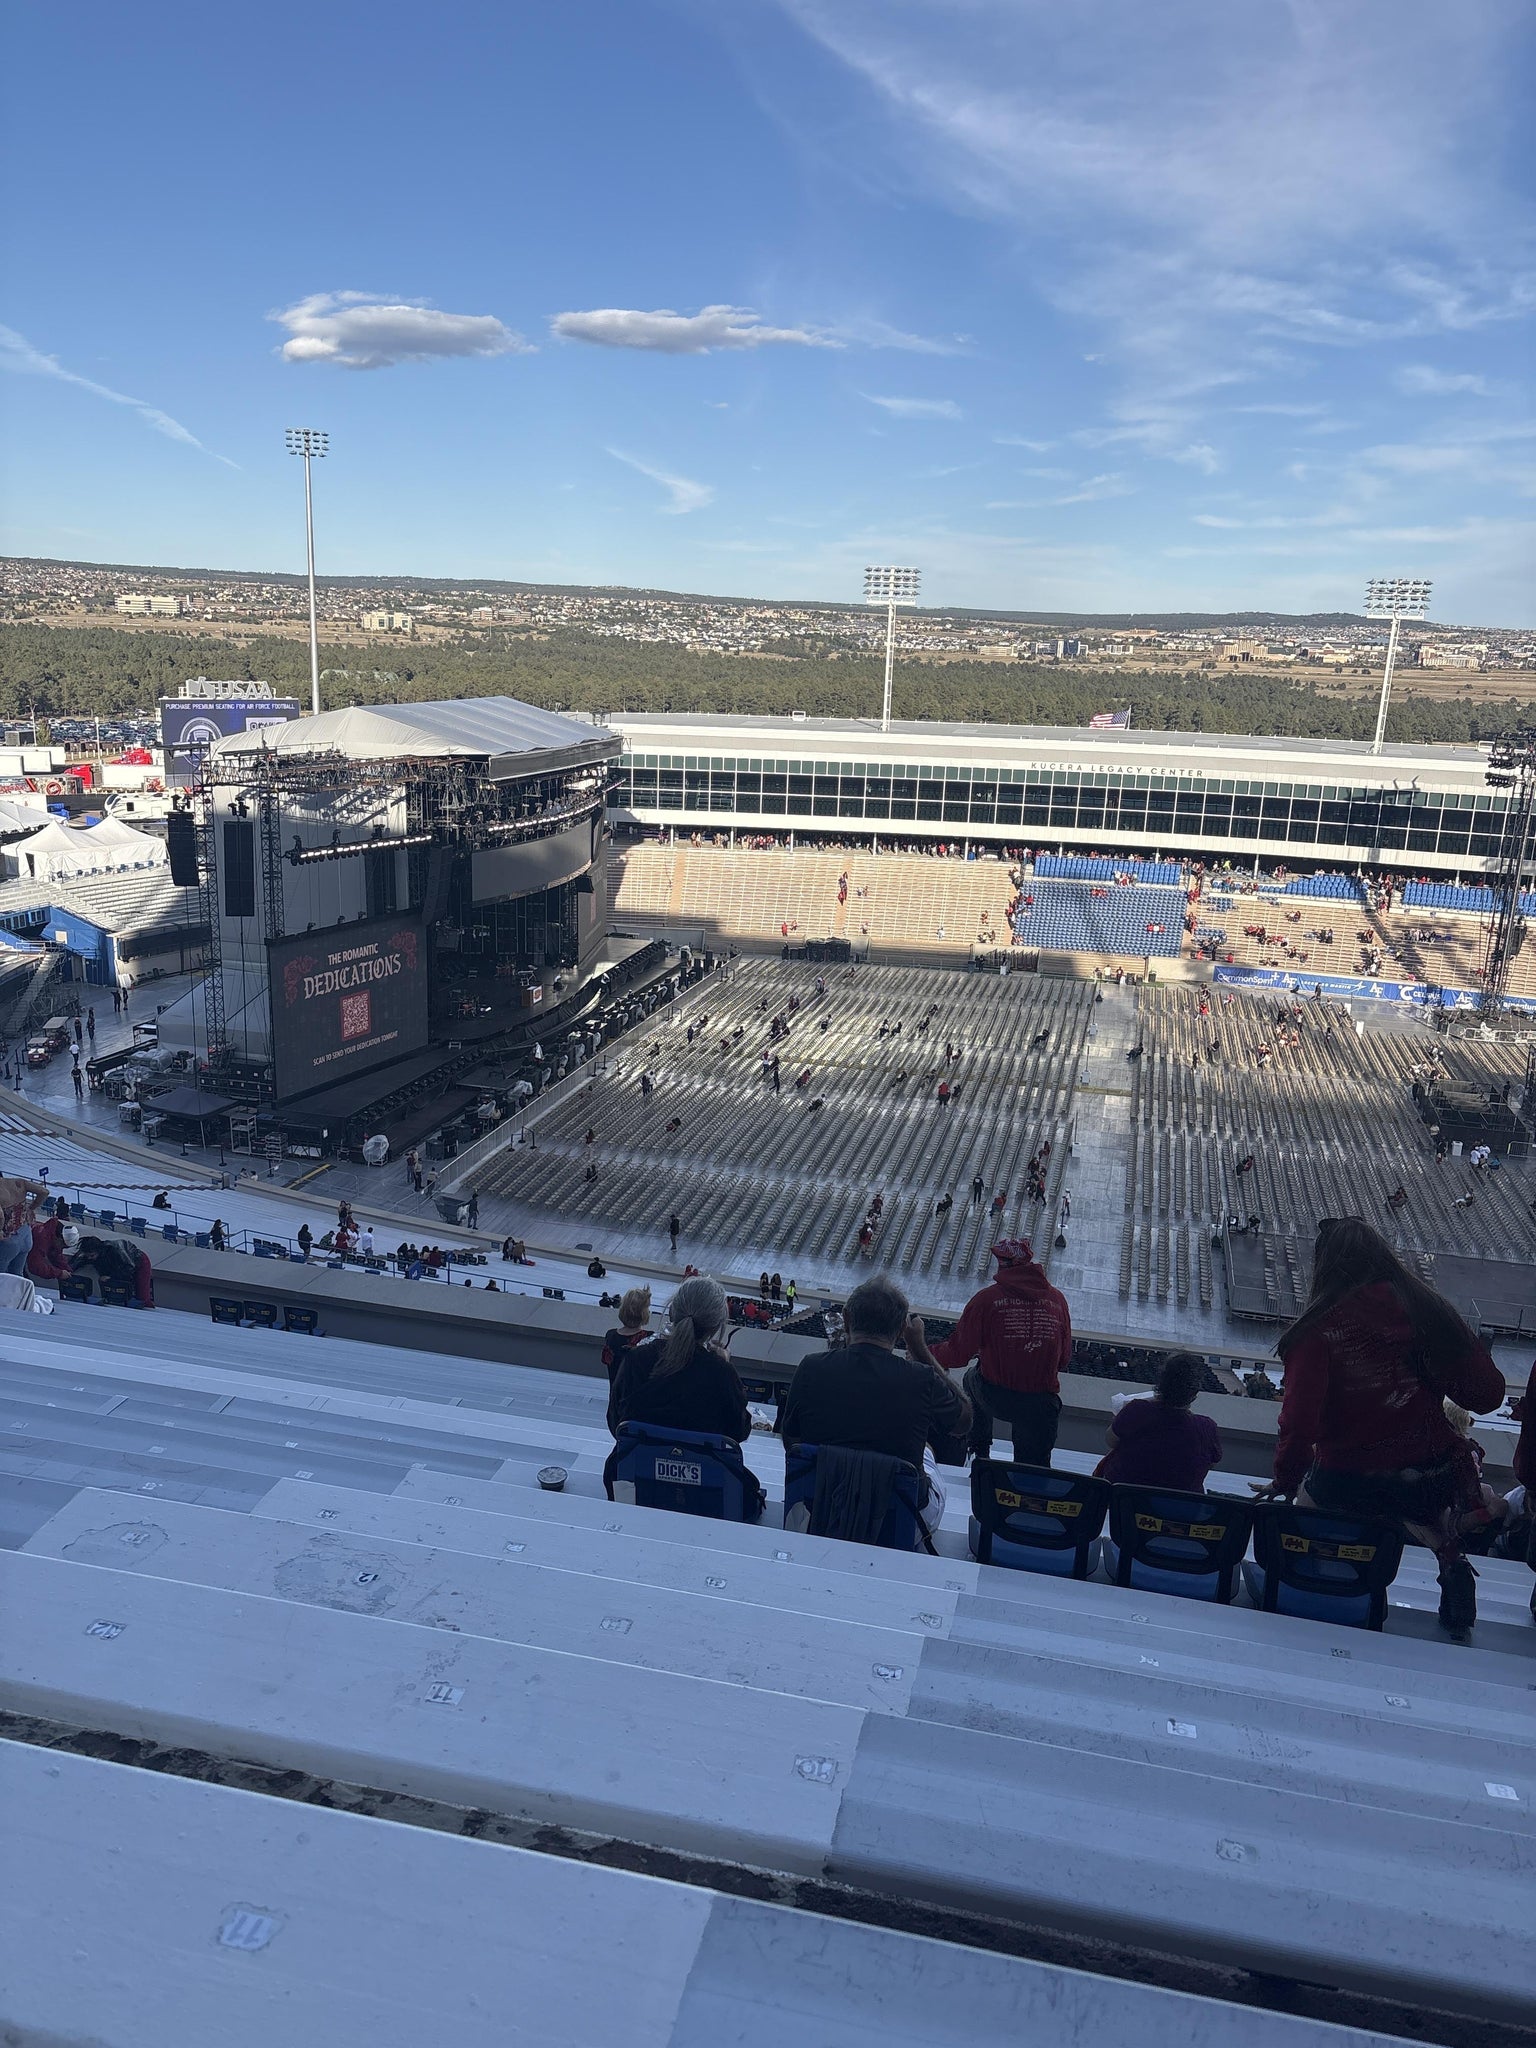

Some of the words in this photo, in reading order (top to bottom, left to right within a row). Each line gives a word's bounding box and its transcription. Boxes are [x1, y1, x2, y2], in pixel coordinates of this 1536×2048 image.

[217, 680, 273, 699] USAA
[1031, 762, 1082, 771] KUCERA
[1091, 764, 1142, 774] LEGACY
[1151, 767, 1203, 777] CENTER
[327, 953, 342, 966] THE
[343, 942, 379, 962] ROMANTIC
[303, 953, 402, 1000] DEDICATIONS
[1217, 972, 1273, 986] CommonSpirit
[313, 1056, 326, 1067] SCAN
[332, 1049, 344, 1060] SEND
[344, 1044, 357, 1056] YOUR
[356, 1037, 381, 1052] DEDICATION
[381, 1030, 399, 1042] TONIGHT
[657, 1462, 699, 1480] DICK'S
[226, 1914, 264, 1945] 11
